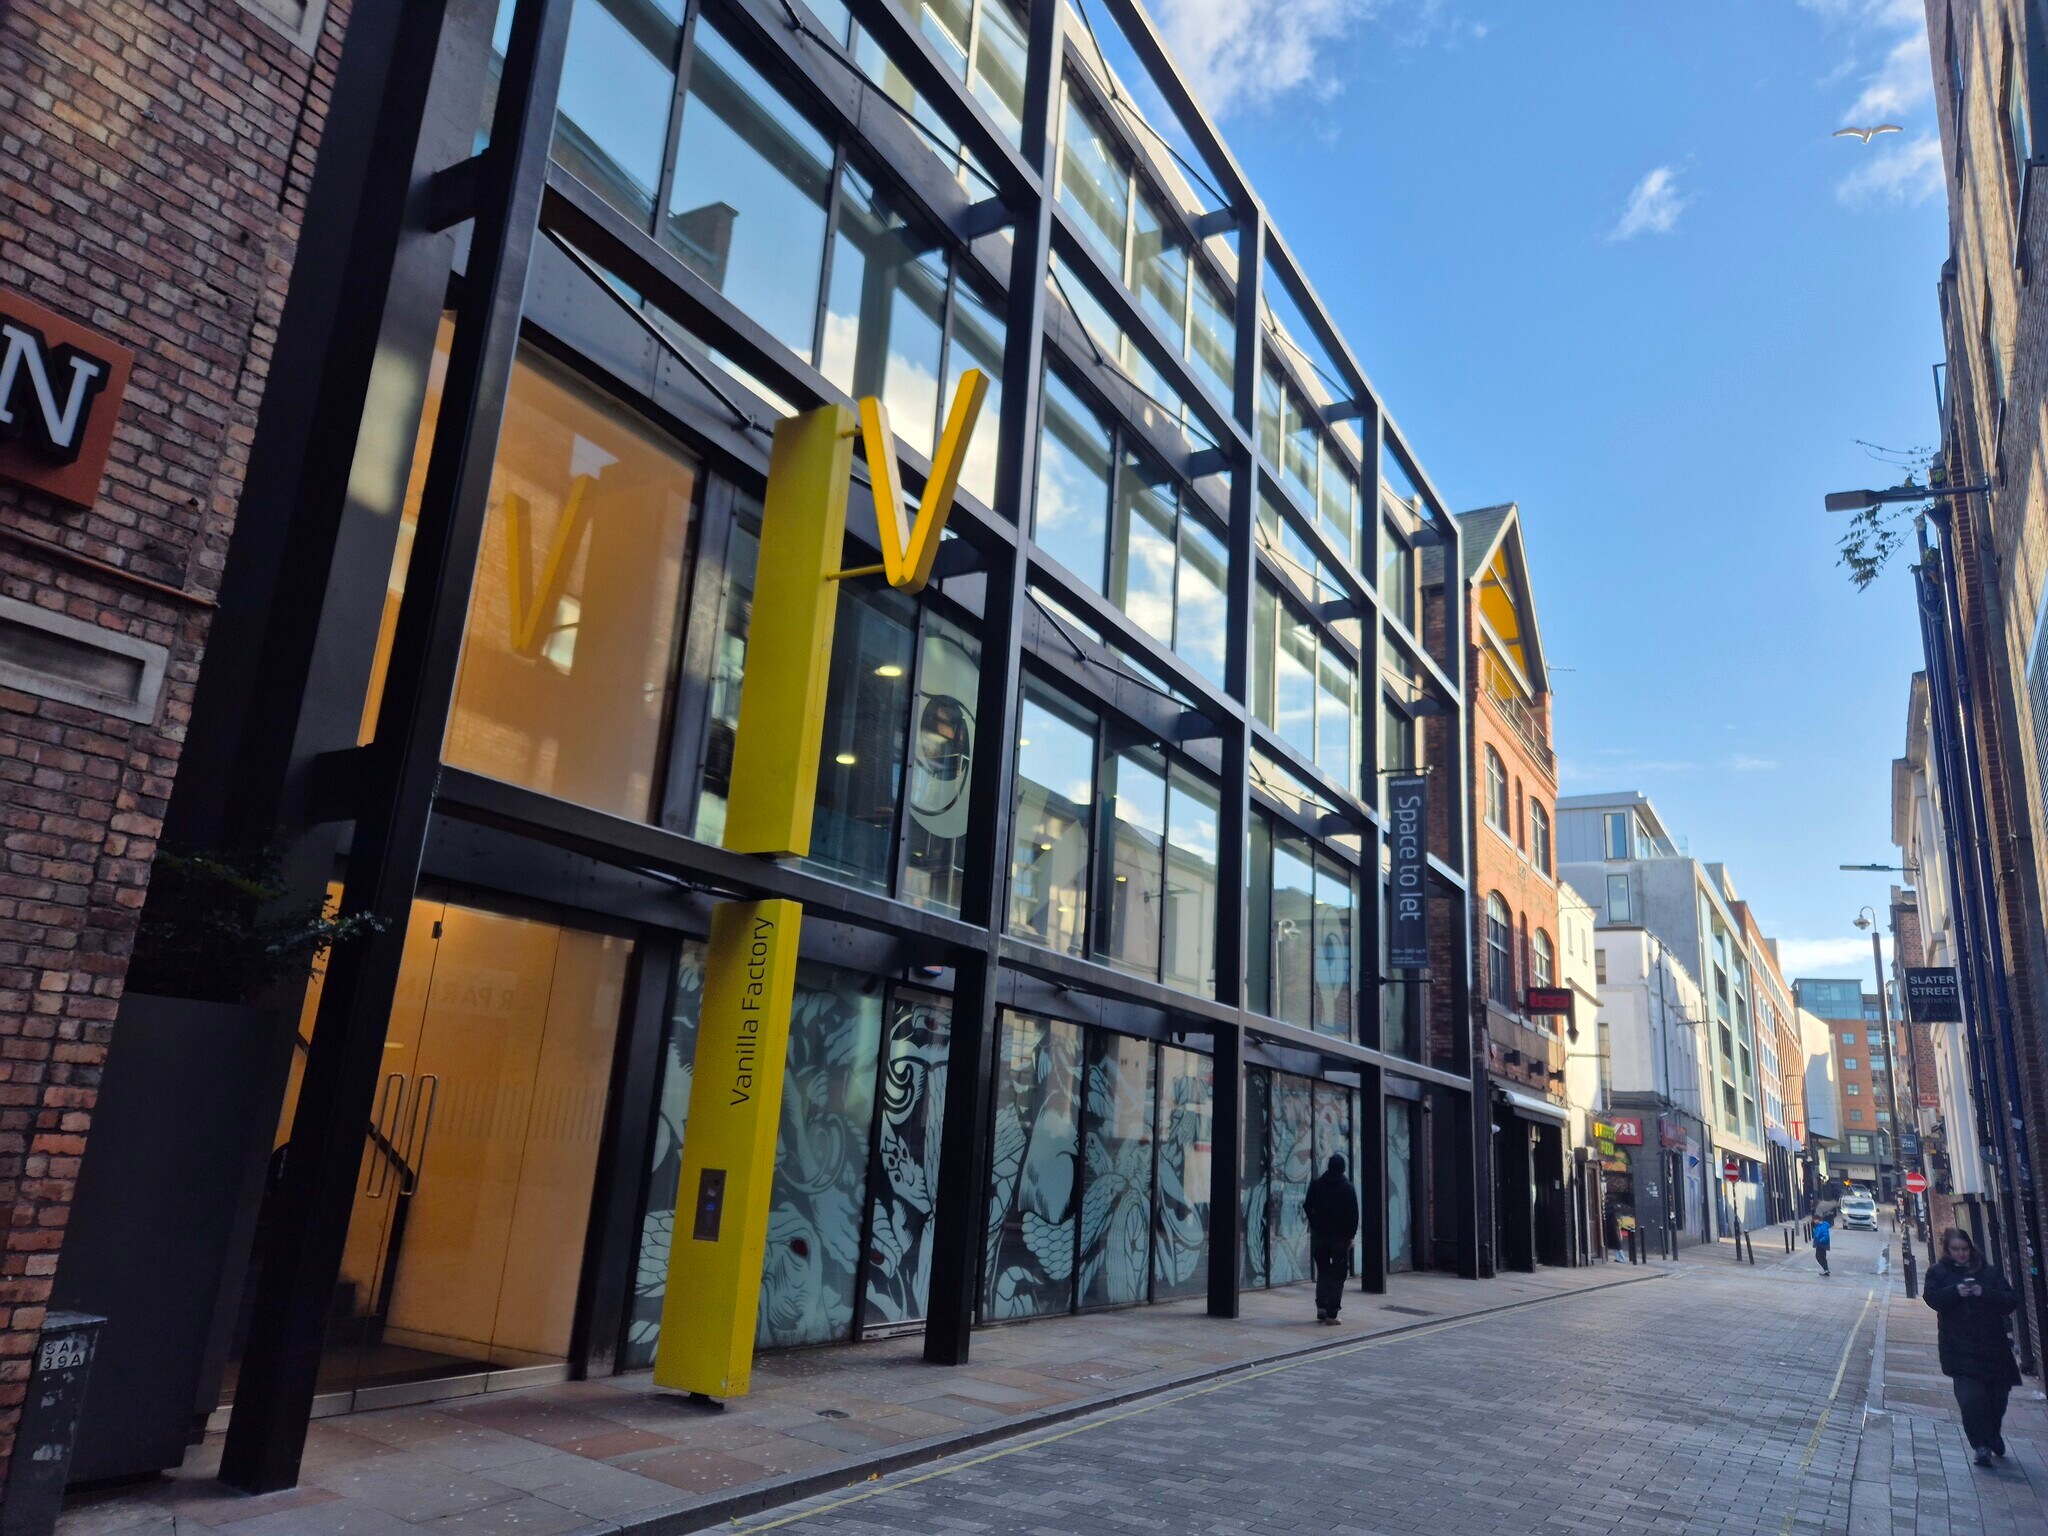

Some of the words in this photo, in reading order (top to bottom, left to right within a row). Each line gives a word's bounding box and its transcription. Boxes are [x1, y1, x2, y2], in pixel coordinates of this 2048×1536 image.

[859, 368, 991, 595] V
[1393, 795, 1422, 859] Space
[1399, 865, 1421, 887] to
[1399, 893, 1423, 921] let
[742, 917, 774, 1010] Factory
[1910, 976, 1955, 985] SLATER
[1911, 986, 1957, 996] STREET
[731, 1021, 759, 1106] Vanilla
[43, 1354, 81, 1369] 39A
